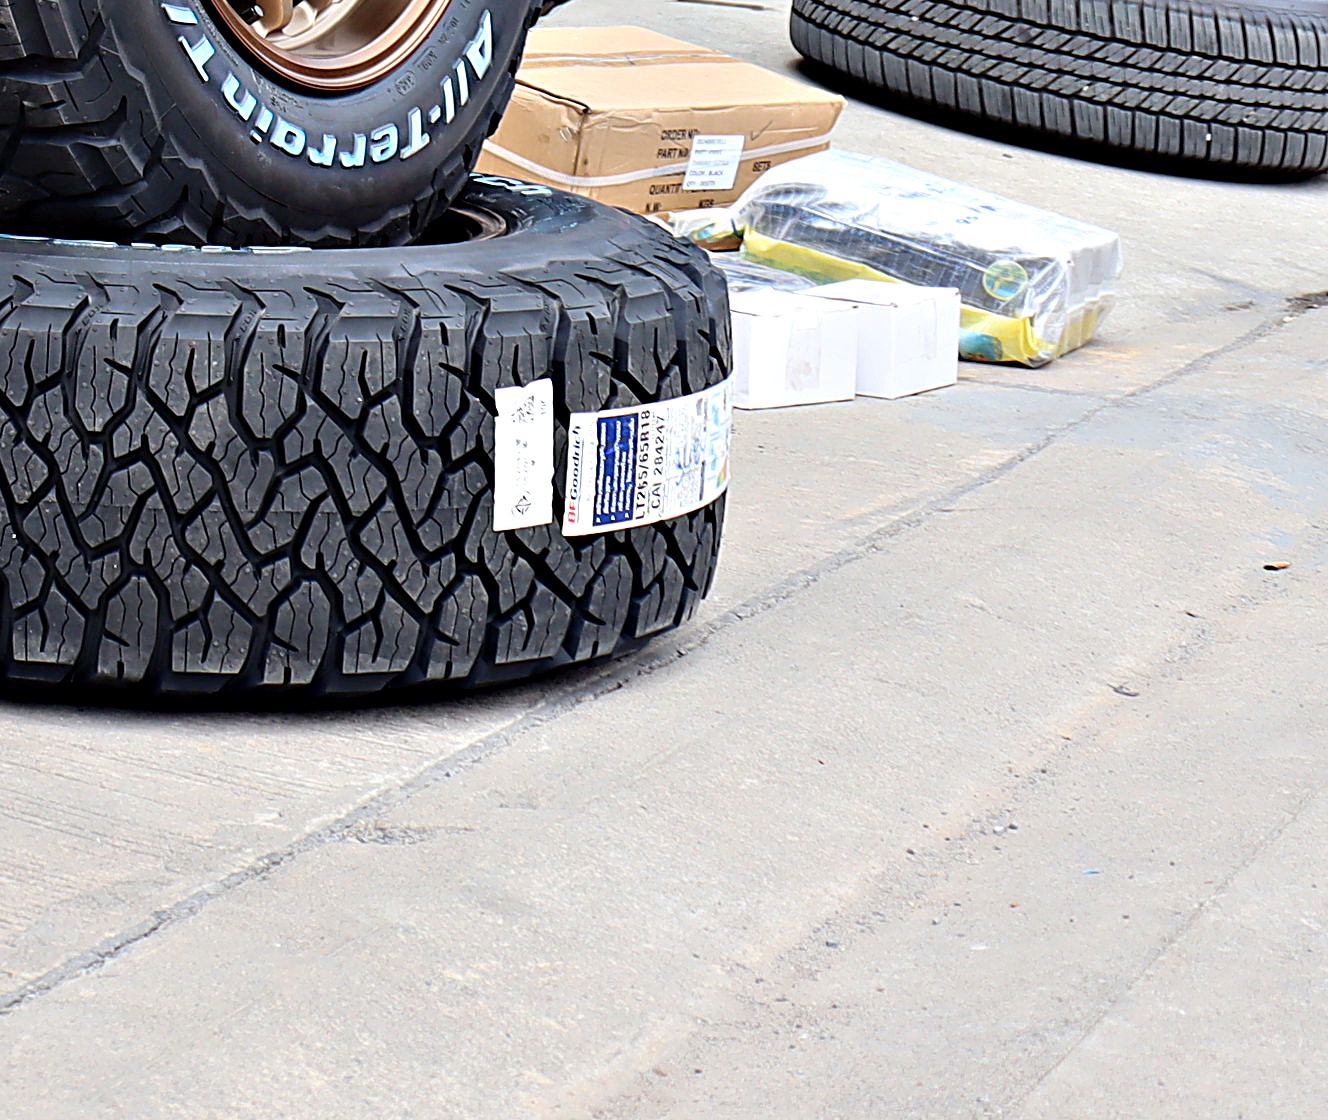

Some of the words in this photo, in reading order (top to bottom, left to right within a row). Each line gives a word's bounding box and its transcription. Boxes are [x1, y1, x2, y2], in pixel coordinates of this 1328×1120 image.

[219, 9, 496, 170] All-Terrain
[656, 149, 677, 159] PART
[660, 131, 688, 141] ORDER
[569, 425, 582, 524] BFGoodrich
